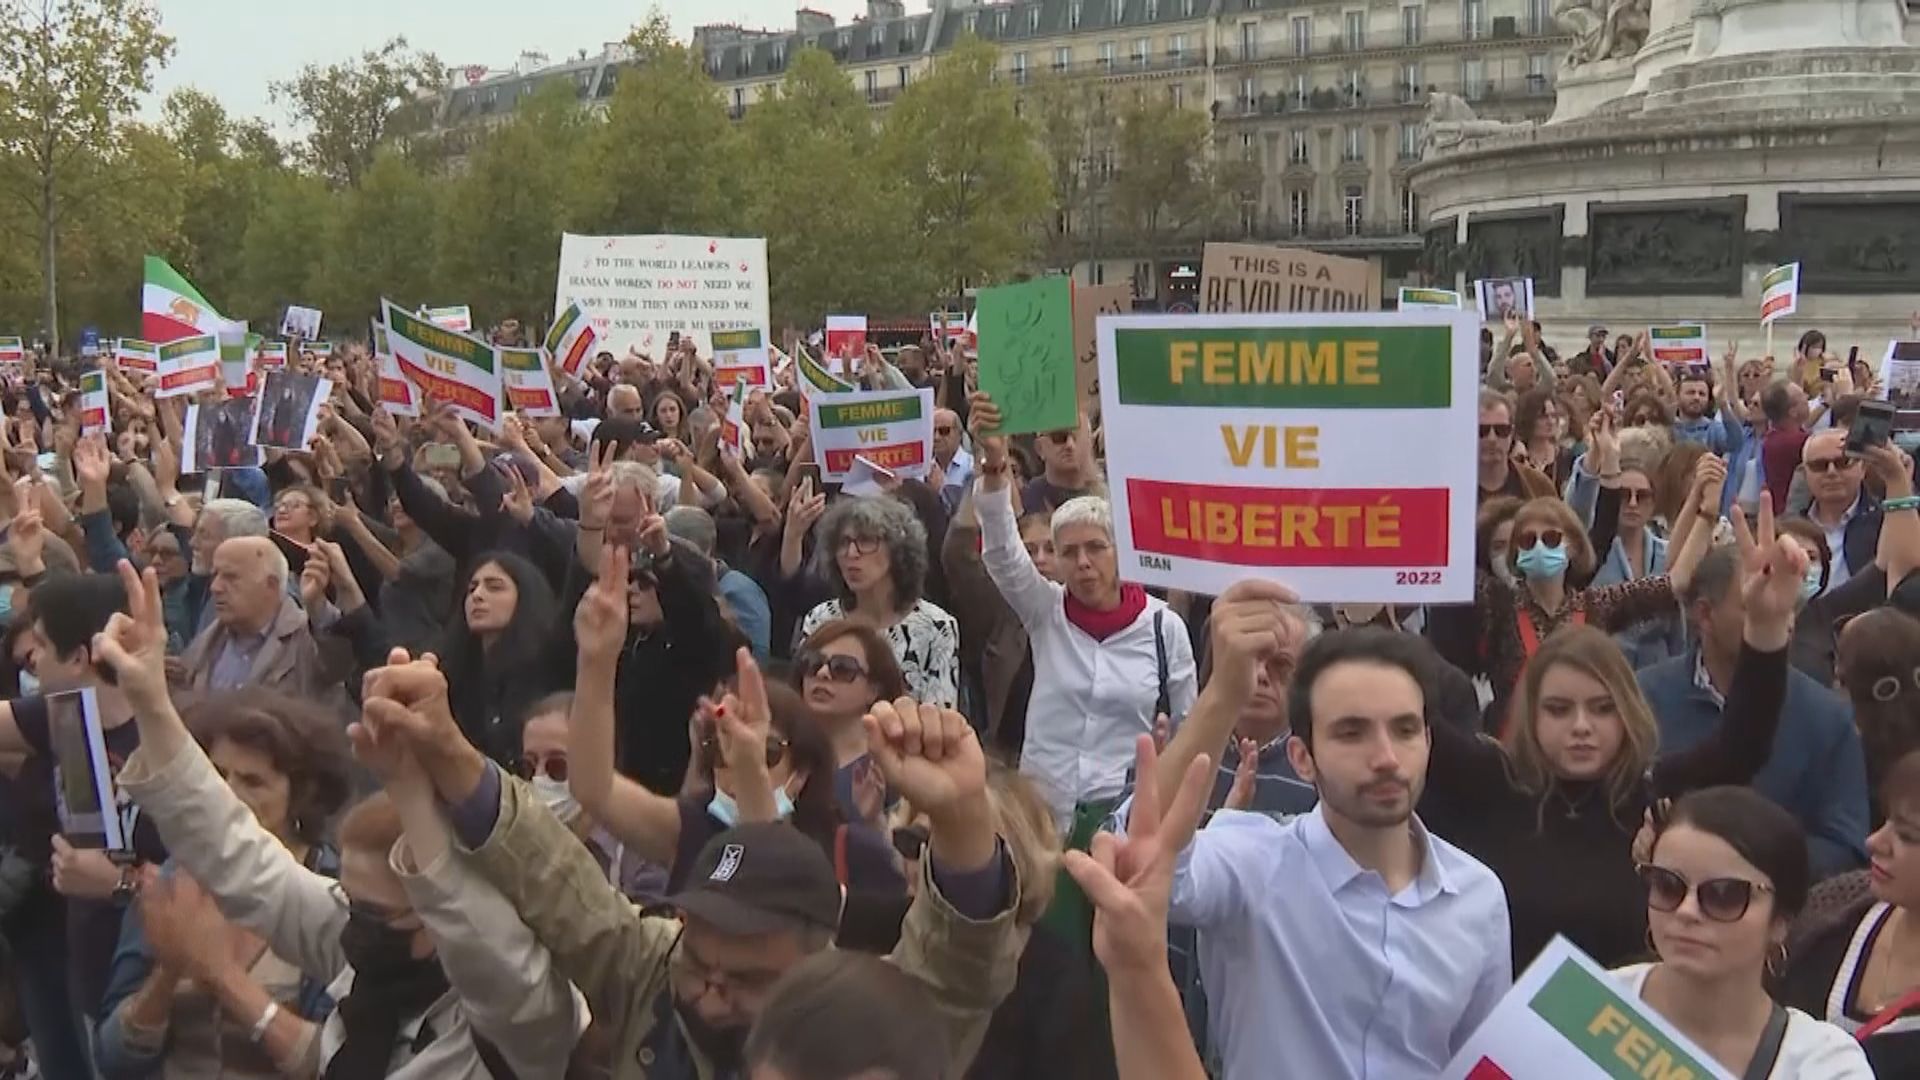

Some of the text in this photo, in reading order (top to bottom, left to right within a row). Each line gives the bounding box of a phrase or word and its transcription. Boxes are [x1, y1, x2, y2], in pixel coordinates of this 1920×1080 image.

[596, 257, 730, 270] TO THE WORLD LEADERS
[1229, 255, 1332, 281] THIS IS A
[569, 275, 610, 287] IRANIAN
[615, 277, 653, 288] WOMEN
[657, 278, 673, 289] DO
[677, 278, 698, 289] NOT
[703, 278, 732, 289] NEED
[609, 298, 637, 309] THEM
[643, 299, 668, 310] THEY
[700, 300, 730, 310] NEED
[1207, 276, 1368, 313] REVOLUTION
[592, 317, 610, 328] TOP
[615, 319, 650, 330] SAVING
[655, 320, 685, 331] THEIR
[405, 319, 476, 354] FEMME
[424, 353, 456, 374] VIE
[1168, 339, 1382, 387] FEMME
[837, 401, 903, 423] FEMME
[856, 427, 888, 443] VIE
[1219, 423, 1320, 469] VIE
[1160, 494, 1402, 549] LIBERTÉ
[1137, 553, 1172, 572] IRAN
[1395, 571, 1442, 586] 2022
